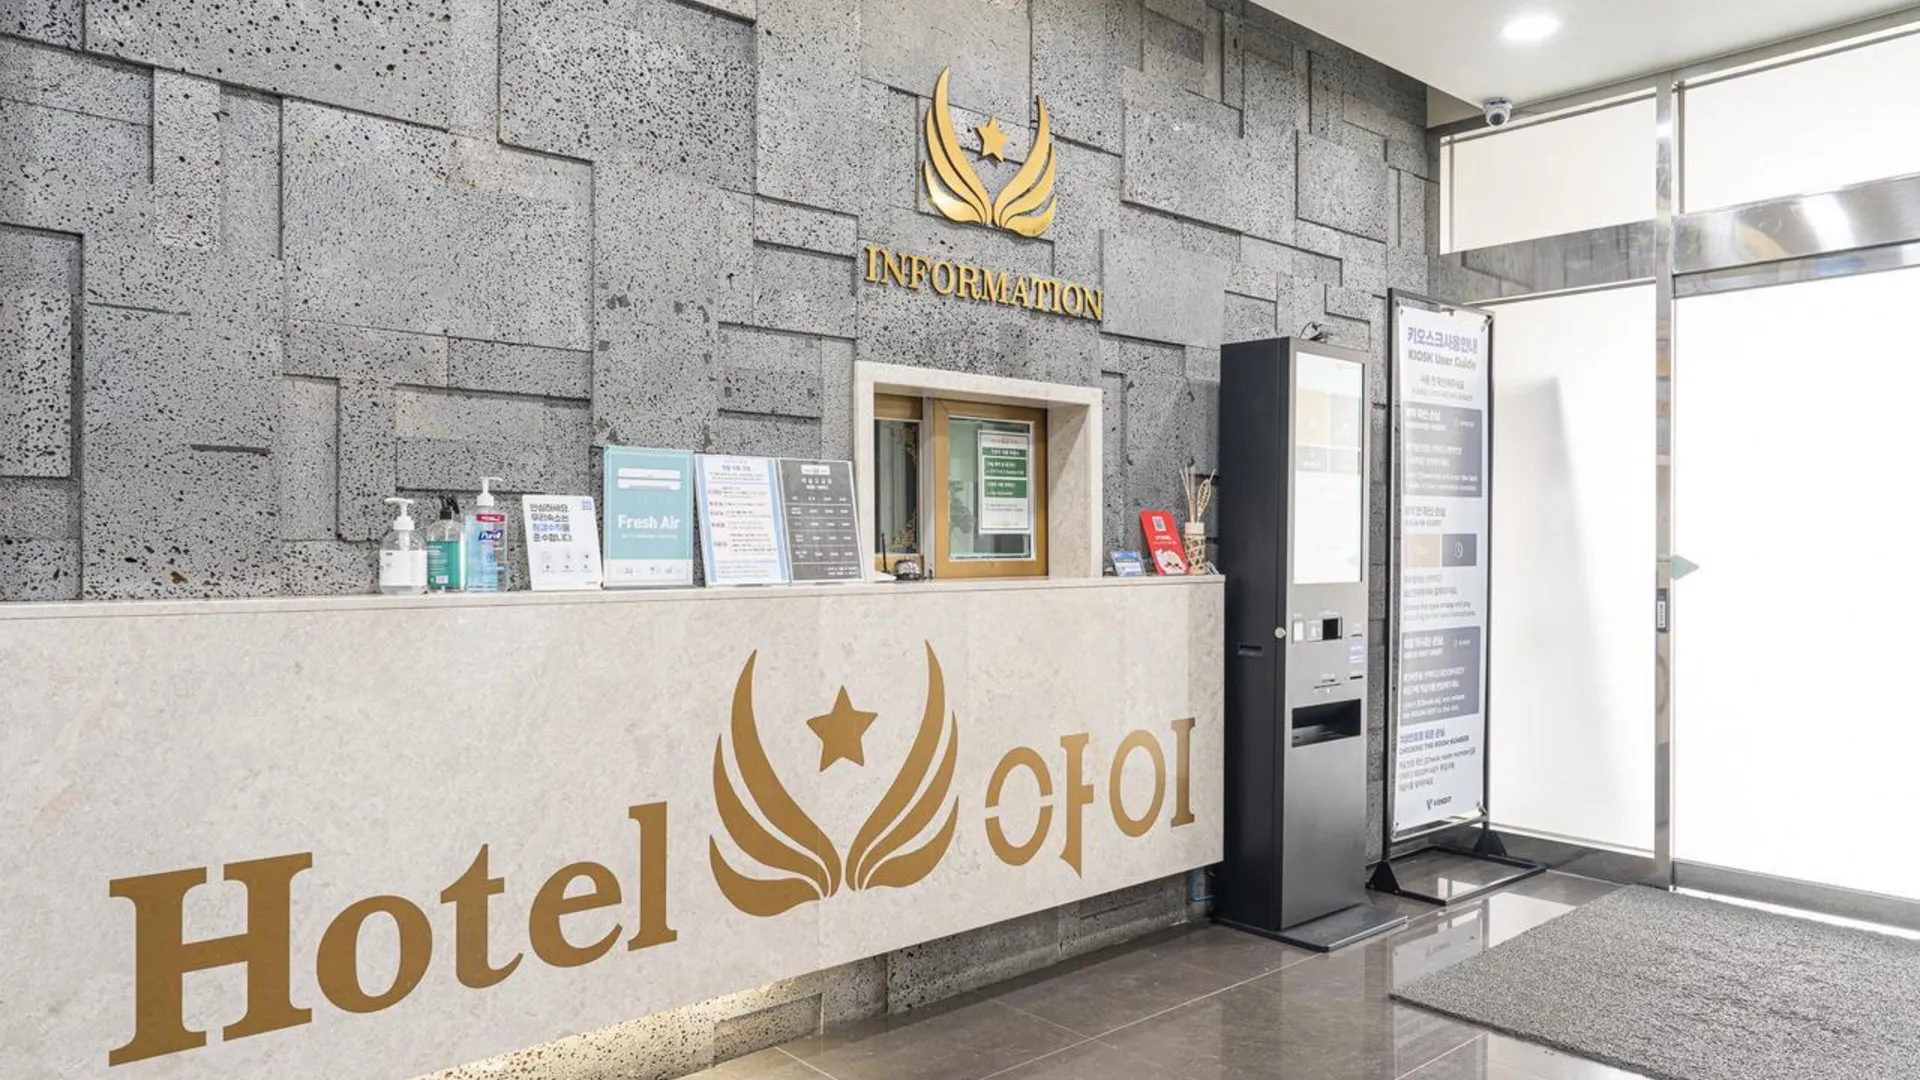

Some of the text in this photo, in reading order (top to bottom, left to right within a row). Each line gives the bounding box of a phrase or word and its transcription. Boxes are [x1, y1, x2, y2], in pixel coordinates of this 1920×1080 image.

[864, 244, 1101, 319] INFORMATION
[1408, 349, 1434, 365] KIOSK
[618, 514, 681, 530] Fresh Air
[109, 801, 677, 1067] Hotel
